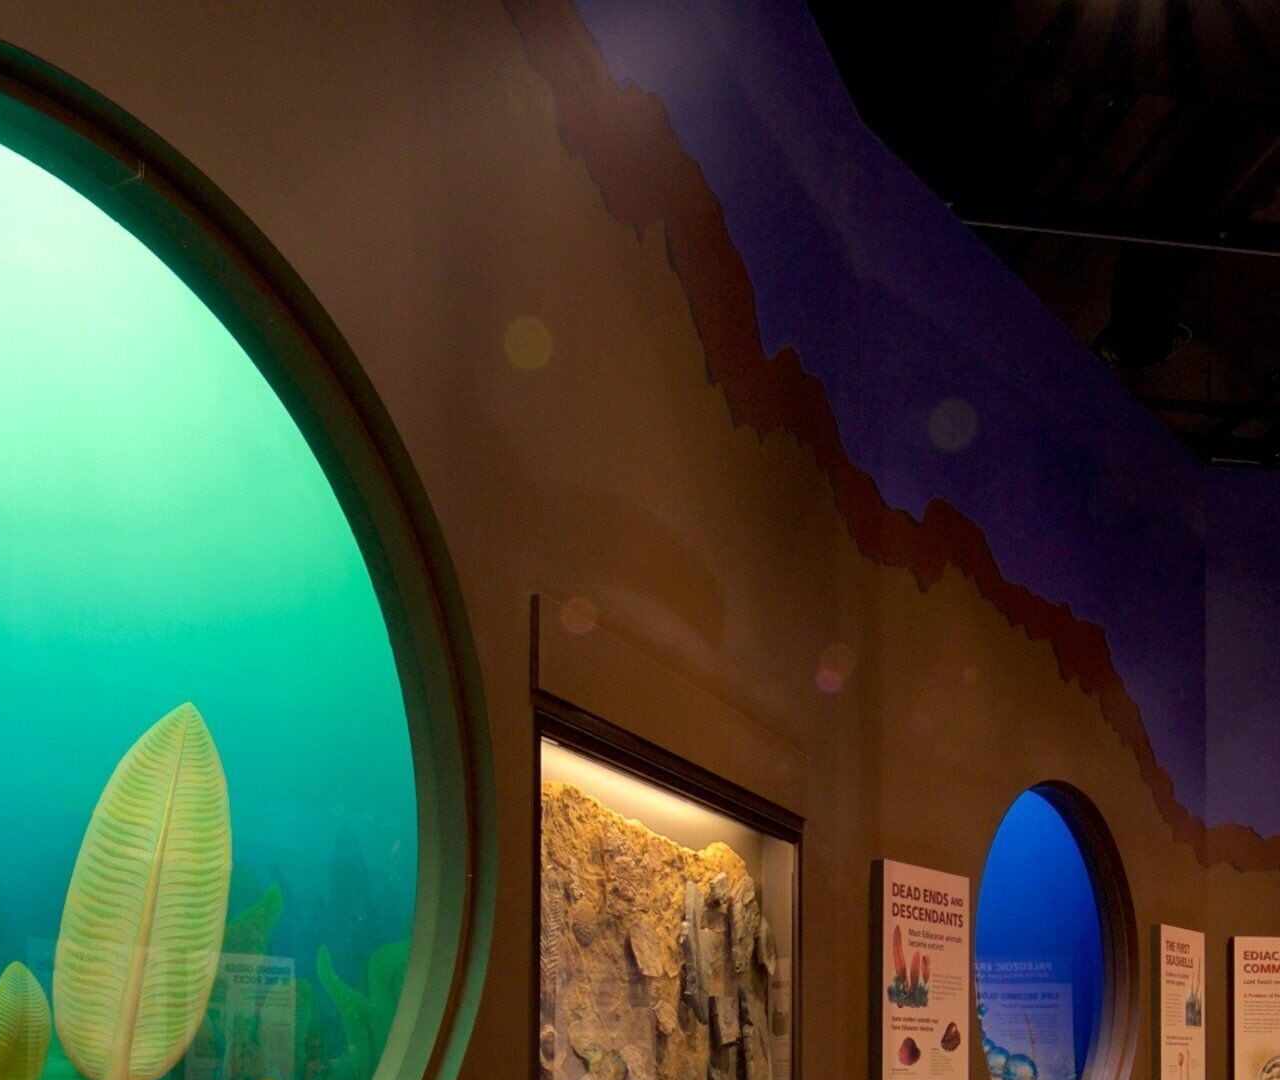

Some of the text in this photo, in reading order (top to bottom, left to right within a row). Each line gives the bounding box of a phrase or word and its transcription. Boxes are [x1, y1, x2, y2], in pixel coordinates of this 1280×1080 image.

[892, 882, 964, 907] DEAD ENDS AND
[892, 902, 964, 928] DESCENDANTS
[1165, 940, 1190, 955] THE FIRST
